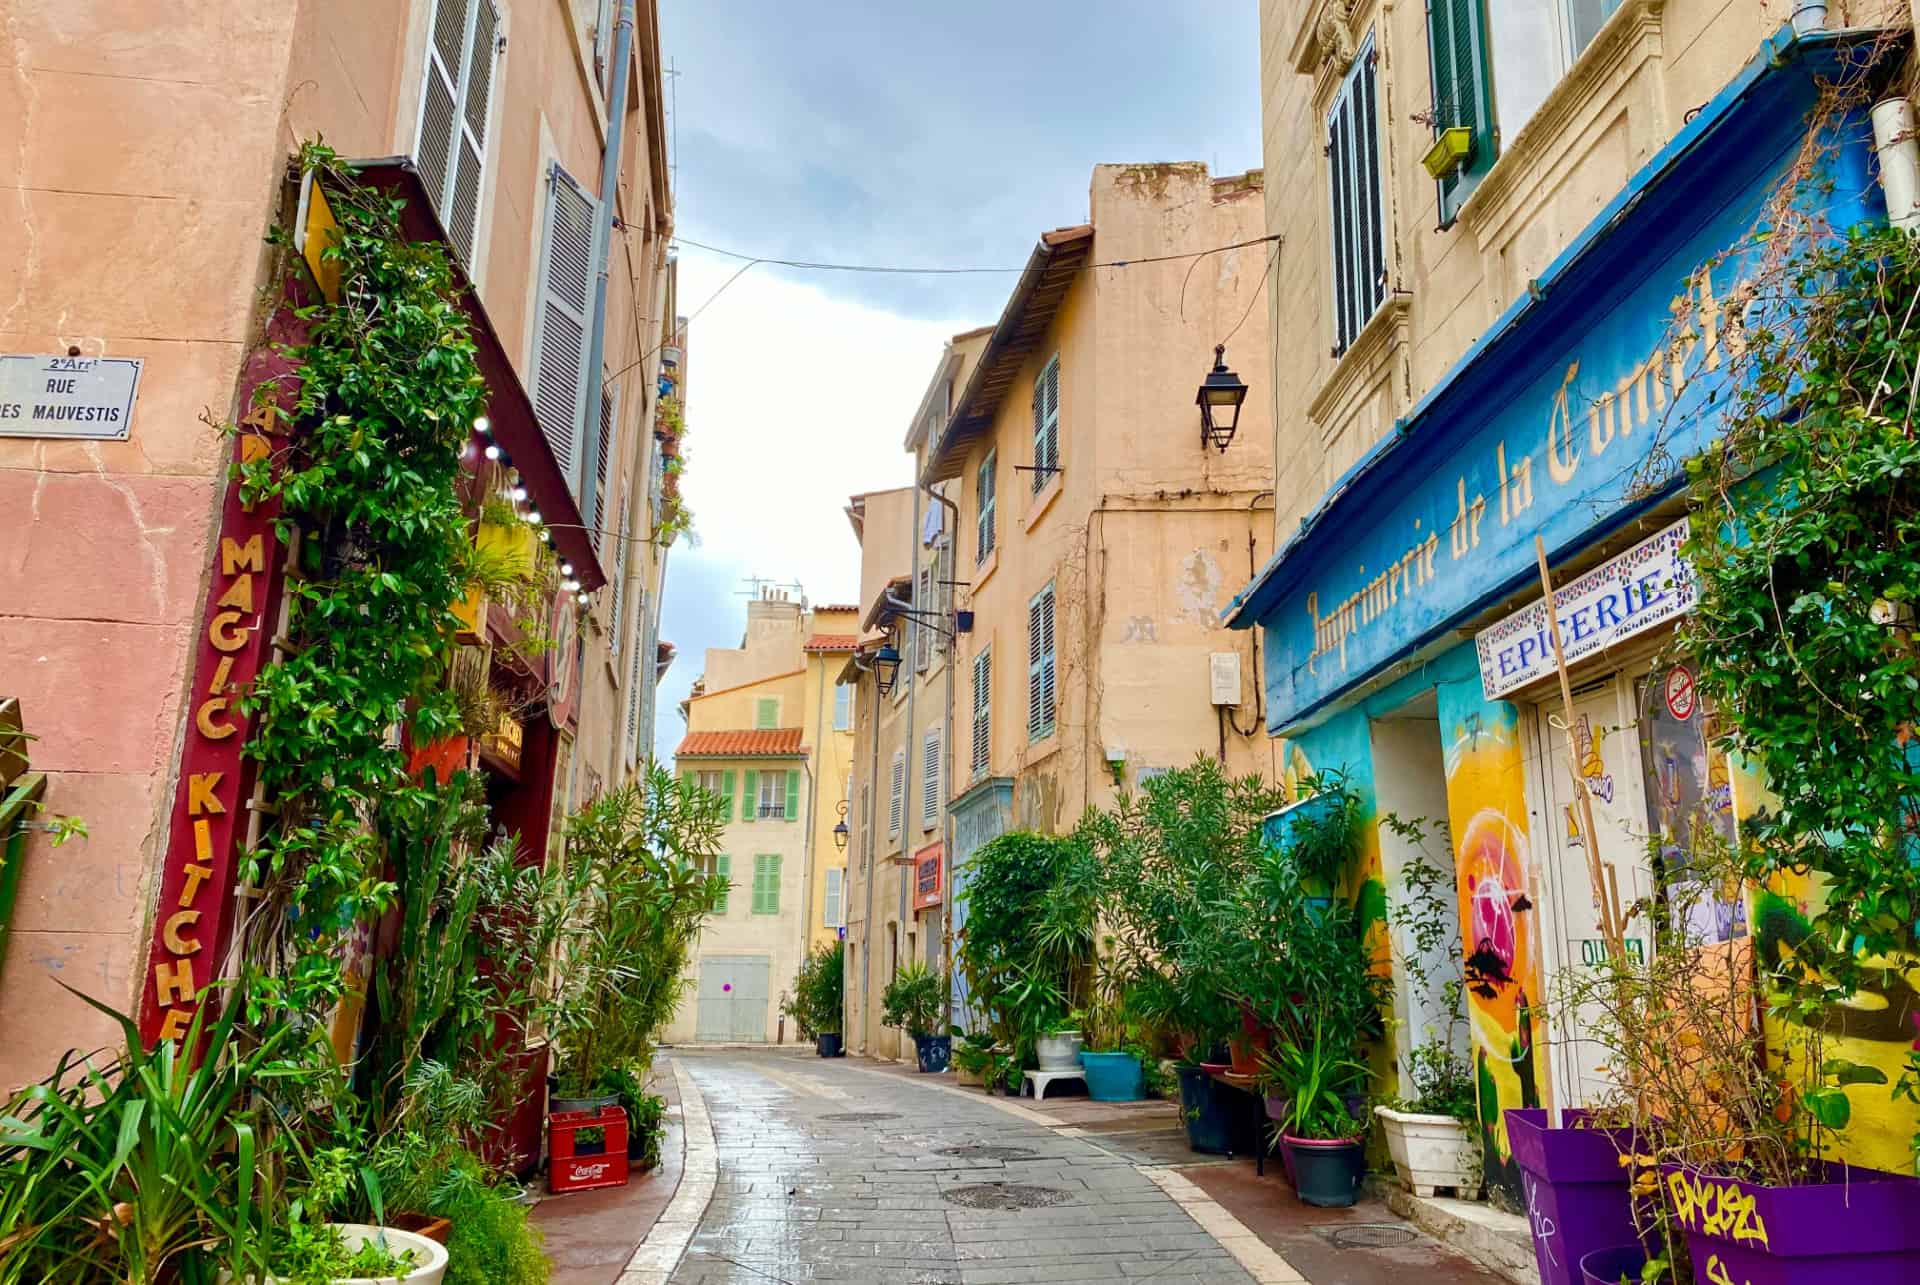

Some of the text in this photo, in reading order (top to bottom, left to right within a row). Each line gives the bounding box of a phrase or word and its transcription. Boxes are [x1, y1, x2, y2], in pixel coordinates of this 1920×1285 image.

[0, 403, 120, 422] ES MAUVESTIS
[46, 378, 76, 394] RUE
[1452, 472, 1486, 561] de
[1497, 440, 1535, 528] la
[196, 534, 264, 740] MAGIC
[1498, 569, 1672, 678] EPICERIE
[154, 772, 227, 1085] KITCHE
